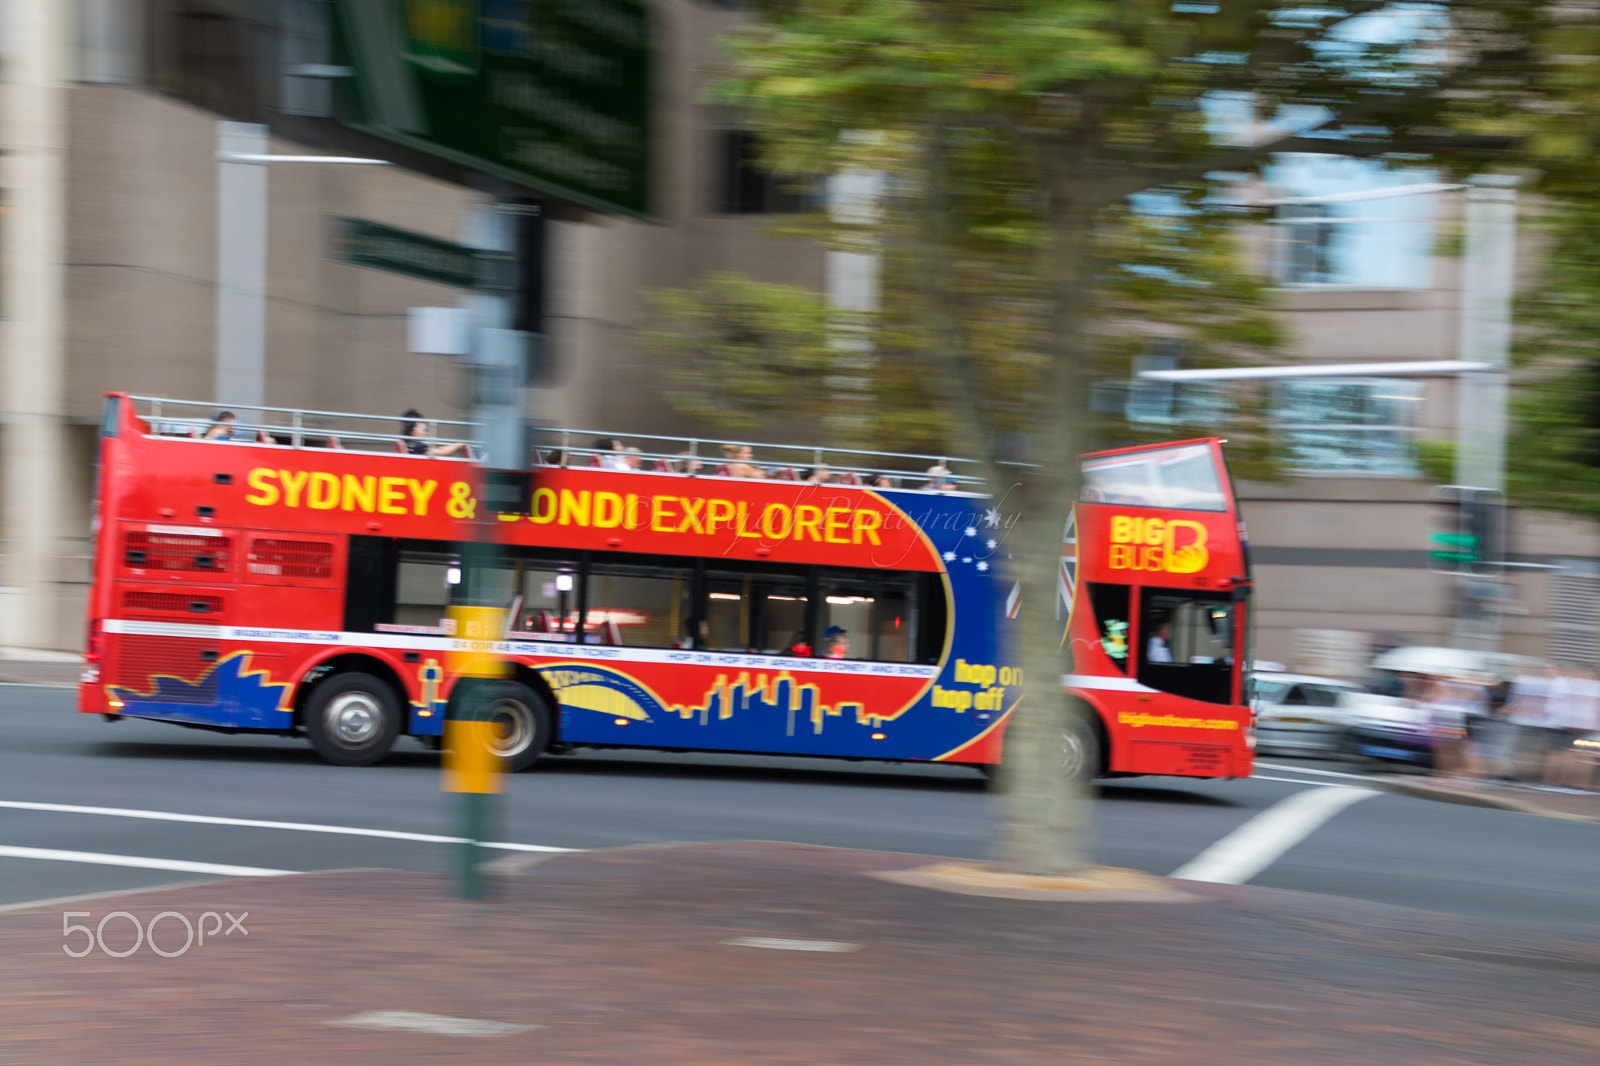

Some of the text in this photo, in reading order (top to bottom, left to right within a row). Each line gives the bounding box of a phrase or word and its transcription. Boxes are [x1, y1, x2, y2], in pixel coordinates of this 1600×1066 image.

[245, 467, 883, 546] SYDNEY & ONDI EXPLORER
[1110, 515, 1165, 545] BIG
[1109, 544, 1165, 572] BUS
[954, 658, 1024, 689] hop on
[931, 685, 1005, 713] hop off
